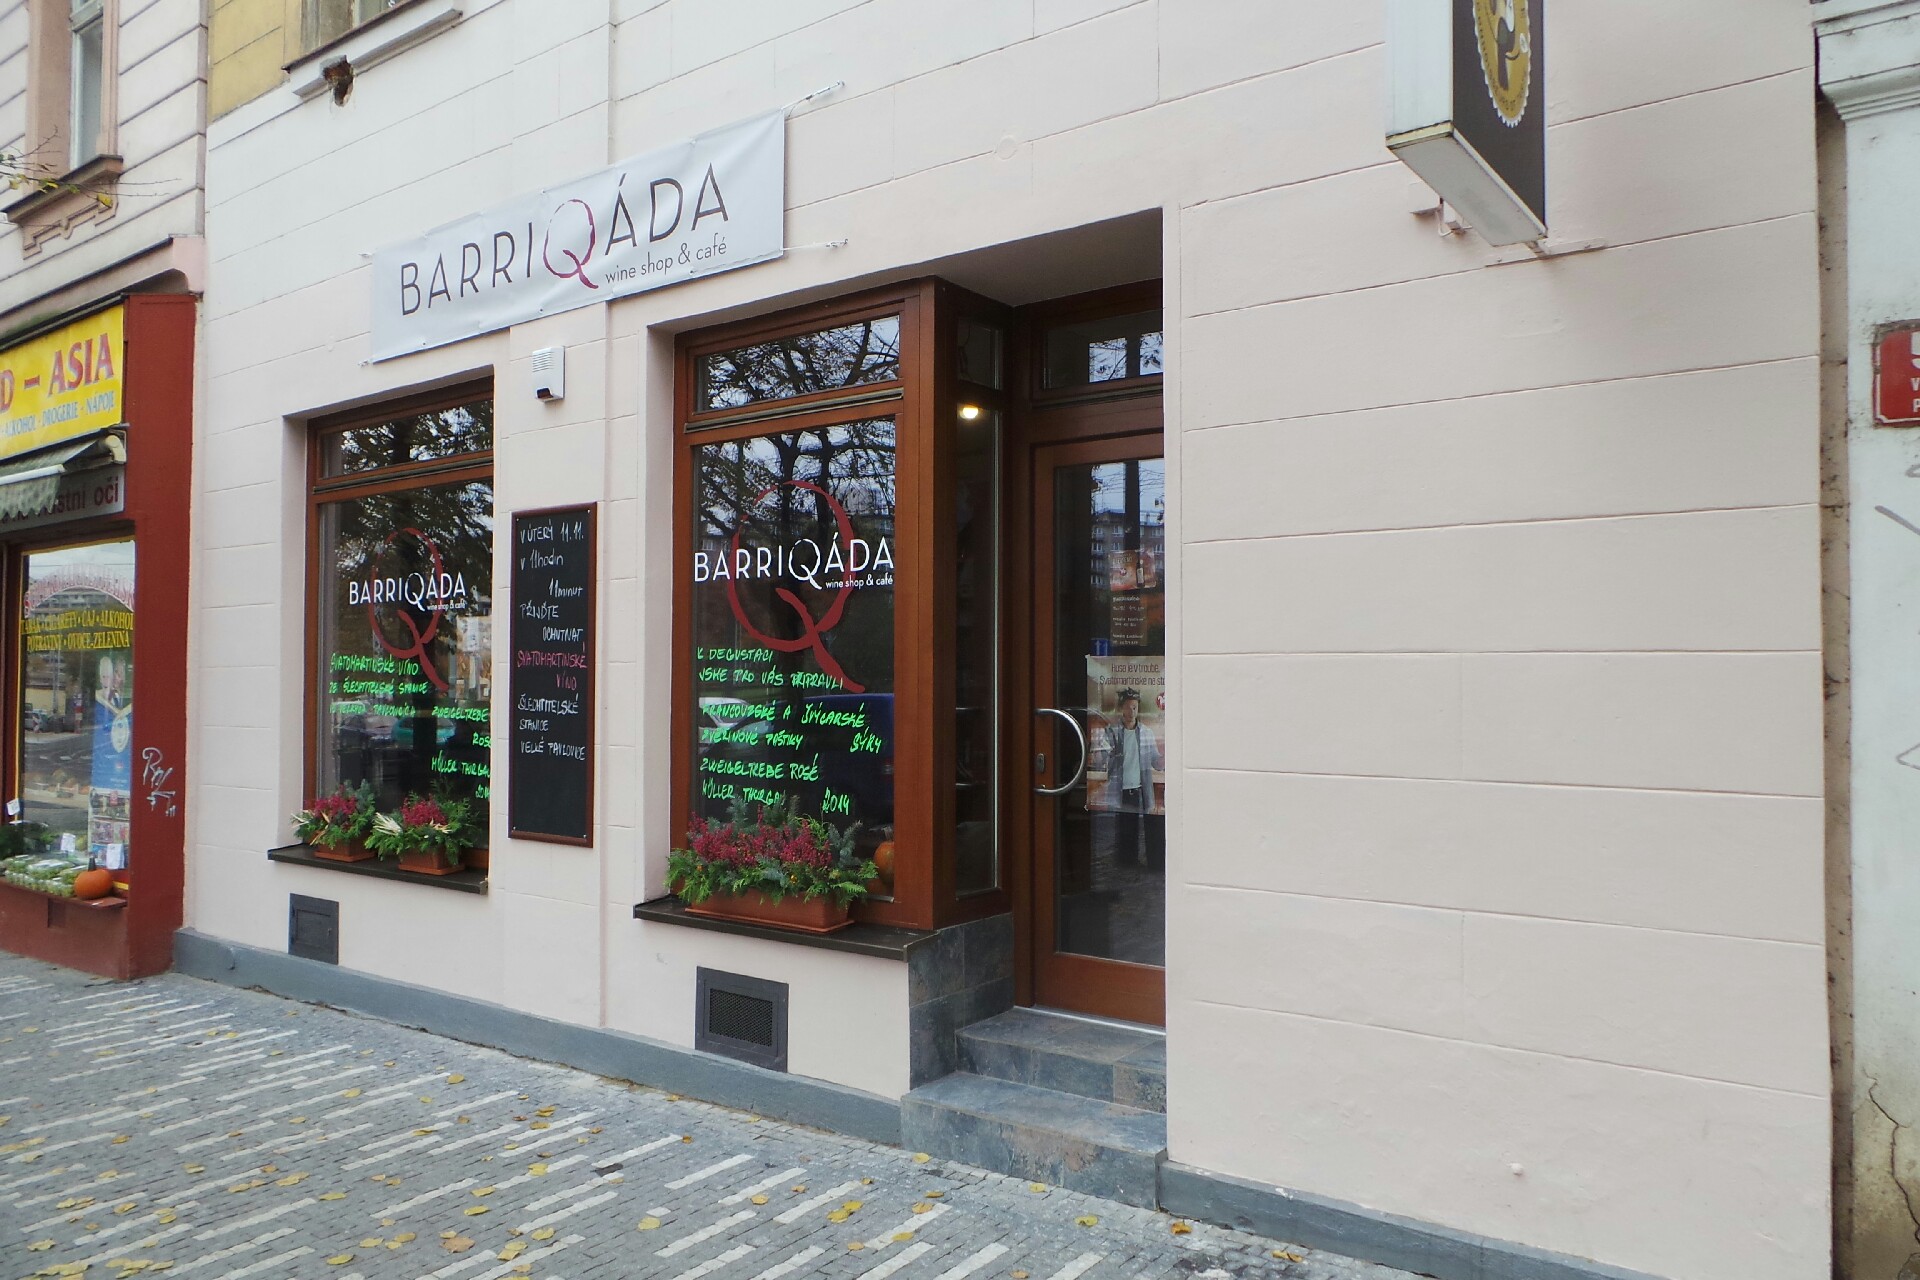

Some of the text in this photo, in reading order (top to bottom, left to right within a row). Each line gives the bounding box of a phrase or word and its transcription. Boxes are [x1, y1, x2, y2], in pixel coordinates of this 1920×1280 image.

[401, 162, 729, 316] BARRIQÁDA
[605, 265, 637, 283] wine
[641, 251, 674, 276] shop
[696, 232, 727, 260] café
[48, 332, 115, 398] ASIA
[694, 531, 894, 590] BARRIQÁDA
[825, 576, 844, 589] wine
[845, 575, 865, 590] shop
[876, 572, 894, 586] café
[349, 567, 466, 612] BARRIQÁDA
[734, 670, 755, 683] PRO
[761, 665, 784, 686] VÁS
[783, 705, 791, 721] A
[790, 753, 819, 781] ROSÉ
